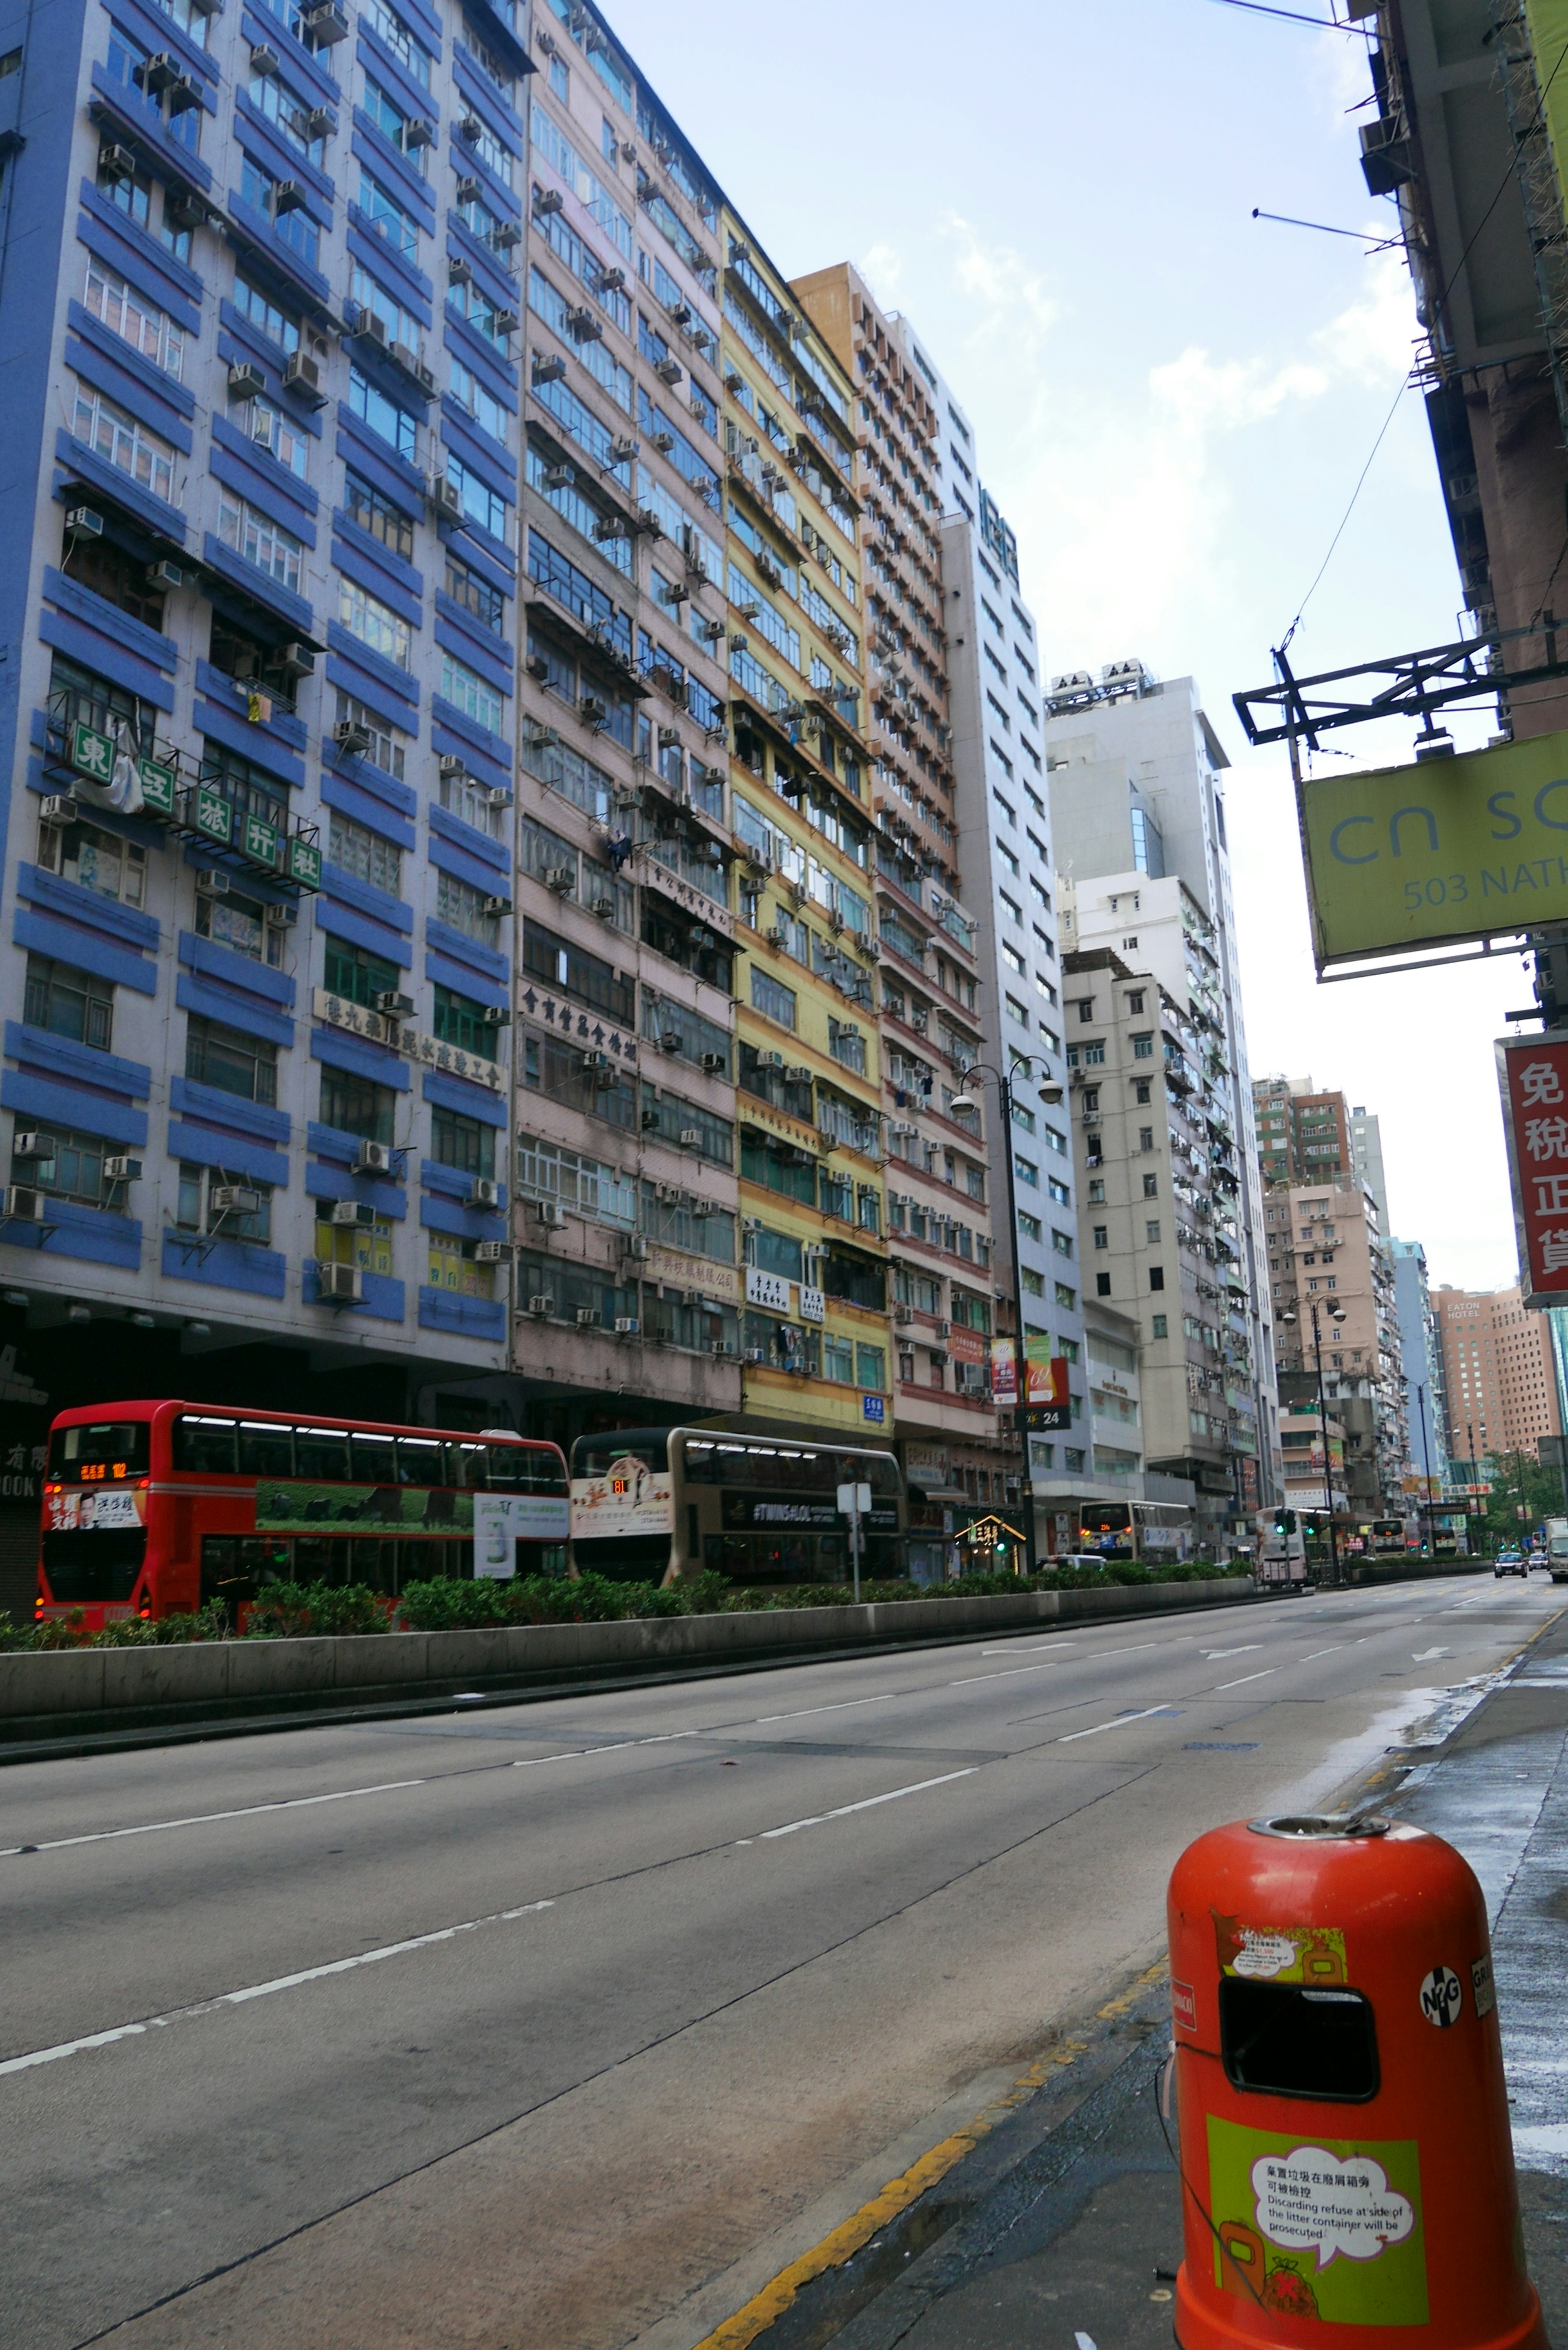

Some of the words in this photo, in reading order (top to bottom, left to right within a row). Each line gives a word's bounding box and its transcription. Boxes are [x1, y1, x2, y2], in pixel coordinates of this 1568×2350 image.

[78, 737, 317, 880] 東江旅行社
[1404, 873, 1468, 911] 503
[1447, 1302, 1480, 1312] EATON
[1448, 1311, 1480, 1320] HOTEL
[1043, 1412, 1060, 1425] 24
[614, 1480, 626, 1494] 81
[1267, 2181, 1311, 2199] 可被檢控
[1268, 2195, 1318, 2214] Discarding
[1321, 2204, 1353, 2215] refuse
[1356, 2207, 1366, 2216] at
[1369, 2206, 1389, 2216] side
[1392, 2206, 1403, 2216] of
[1269, 2208, 1284, 2219] the
[1286, 2213, 1310, 2224] litter
[1312, 2216, 1361, 2230] container
[1364, 2220, 1383, 2230] will
[1385, 2221, 1399, 2231] be
[1270, 2223, 1323, 2239] prosecuted
